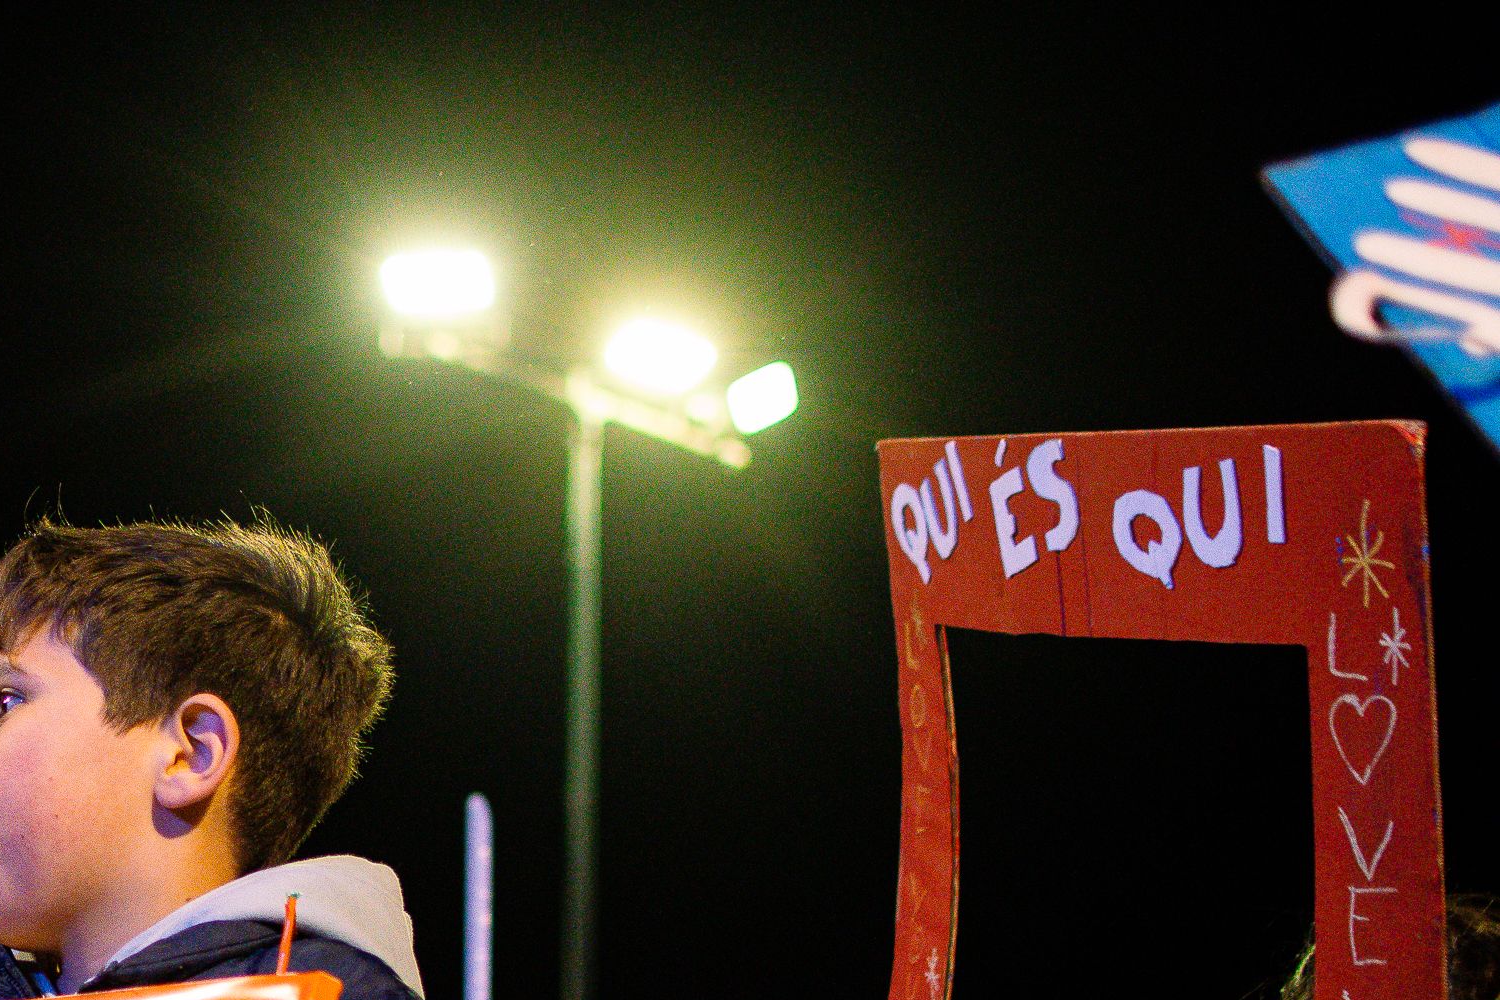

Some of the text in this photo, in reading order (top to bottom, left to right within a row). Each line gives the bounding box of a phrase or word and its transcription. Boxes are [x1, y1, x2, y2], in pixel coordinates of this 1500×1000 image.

[890, 438, 1286, 589] QUI ÉS QUI
